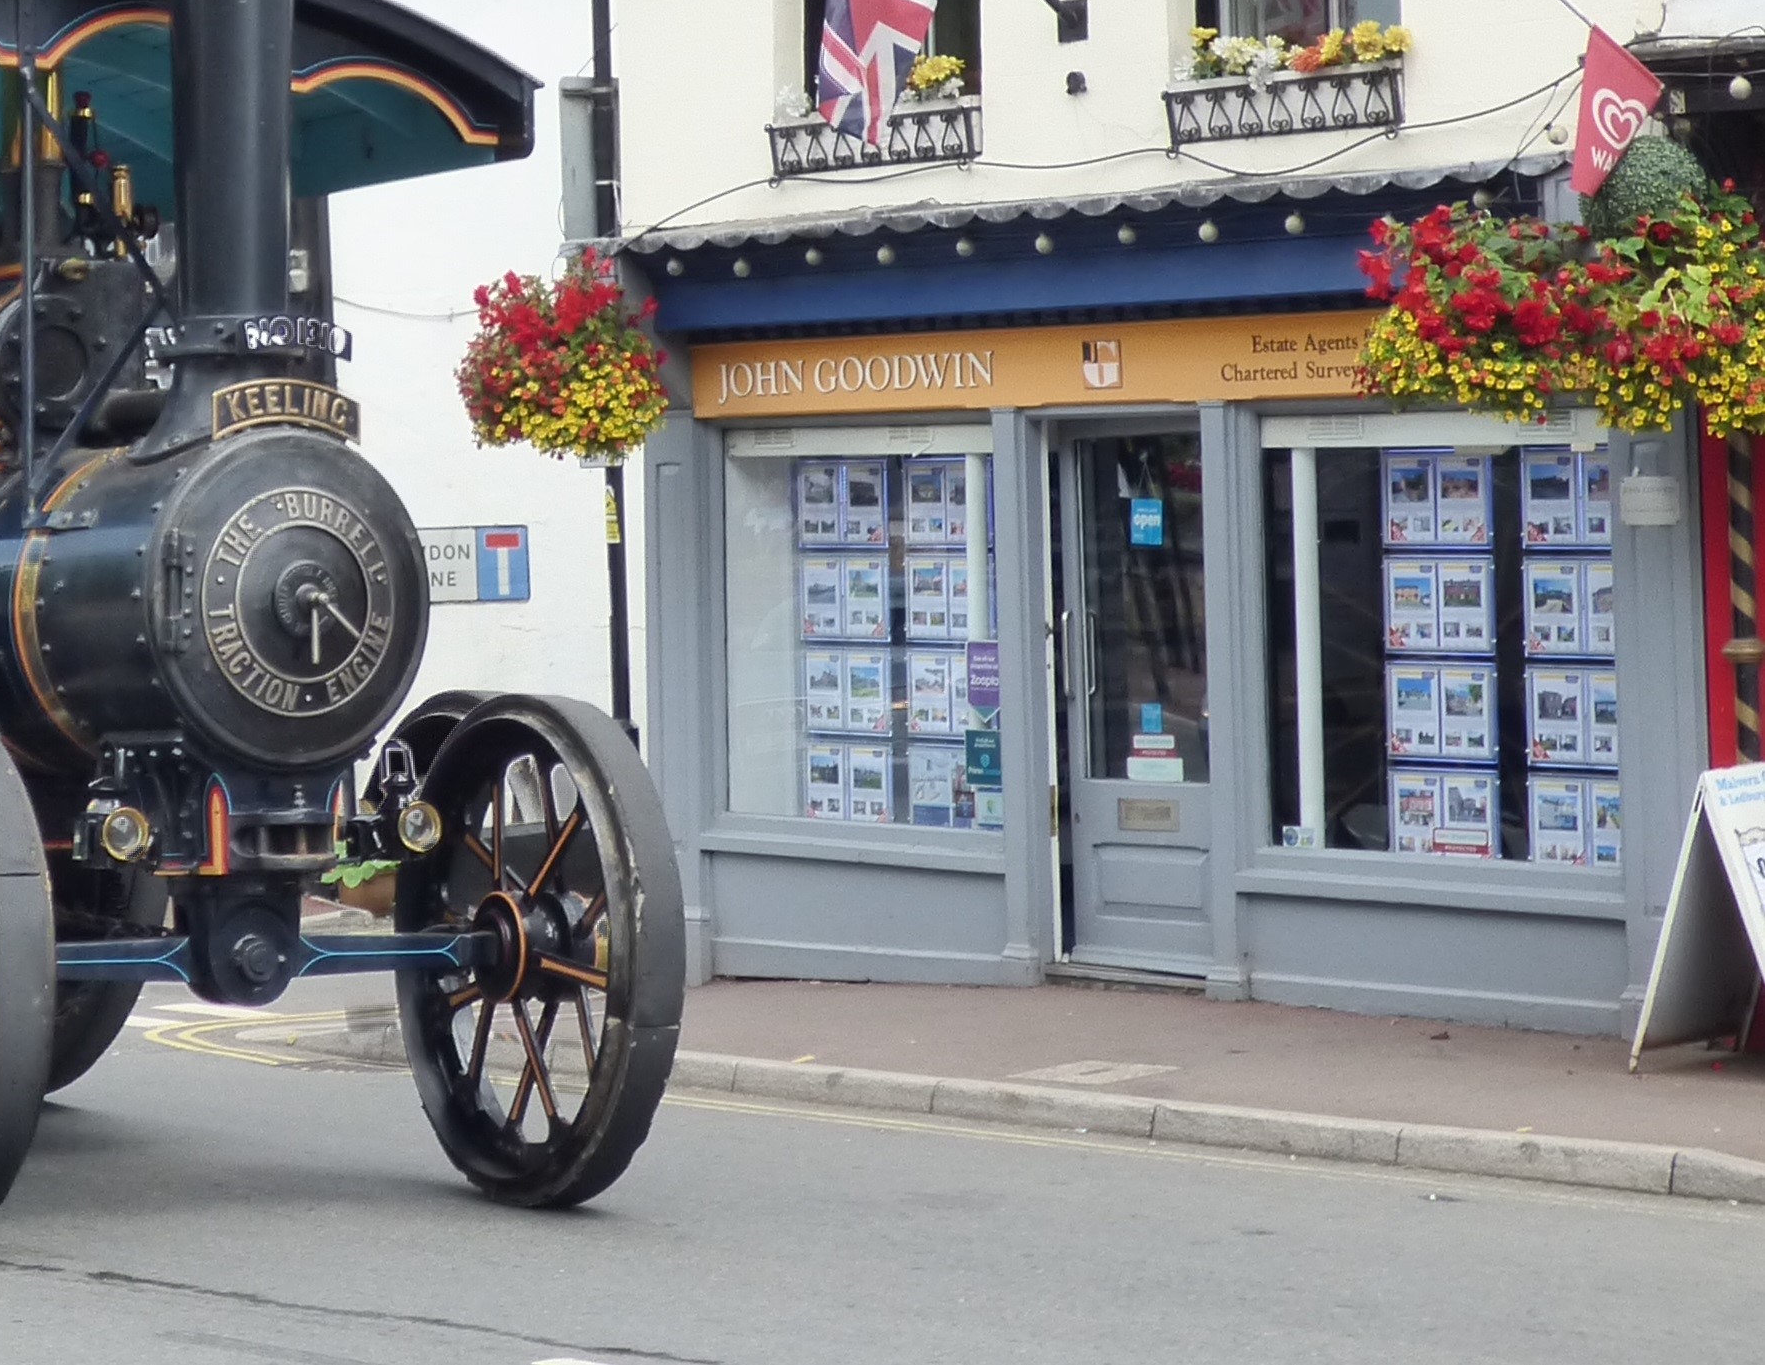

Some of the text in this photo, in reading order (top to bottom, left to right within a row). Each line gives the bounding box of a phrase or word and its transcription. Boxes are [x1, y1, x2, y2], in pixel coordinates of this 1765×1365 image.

[1591, 146, 1619, 173] WA
[1251, 335, 1298, 354] Estate
[1304, 333, 1358, 355] Agents
[718, 350, 994, 405] JOHN GOODWIN
[1220, 361, 1360, 388] Chartered Survey
[225, 384, 348, 430] KEELING
[216, 514, 264, 567] THE
[424, 544, 471, 561] DON
[431, 571, 457, 587] NE
[208, 603, 391, 711] TRACTION ENGINE
